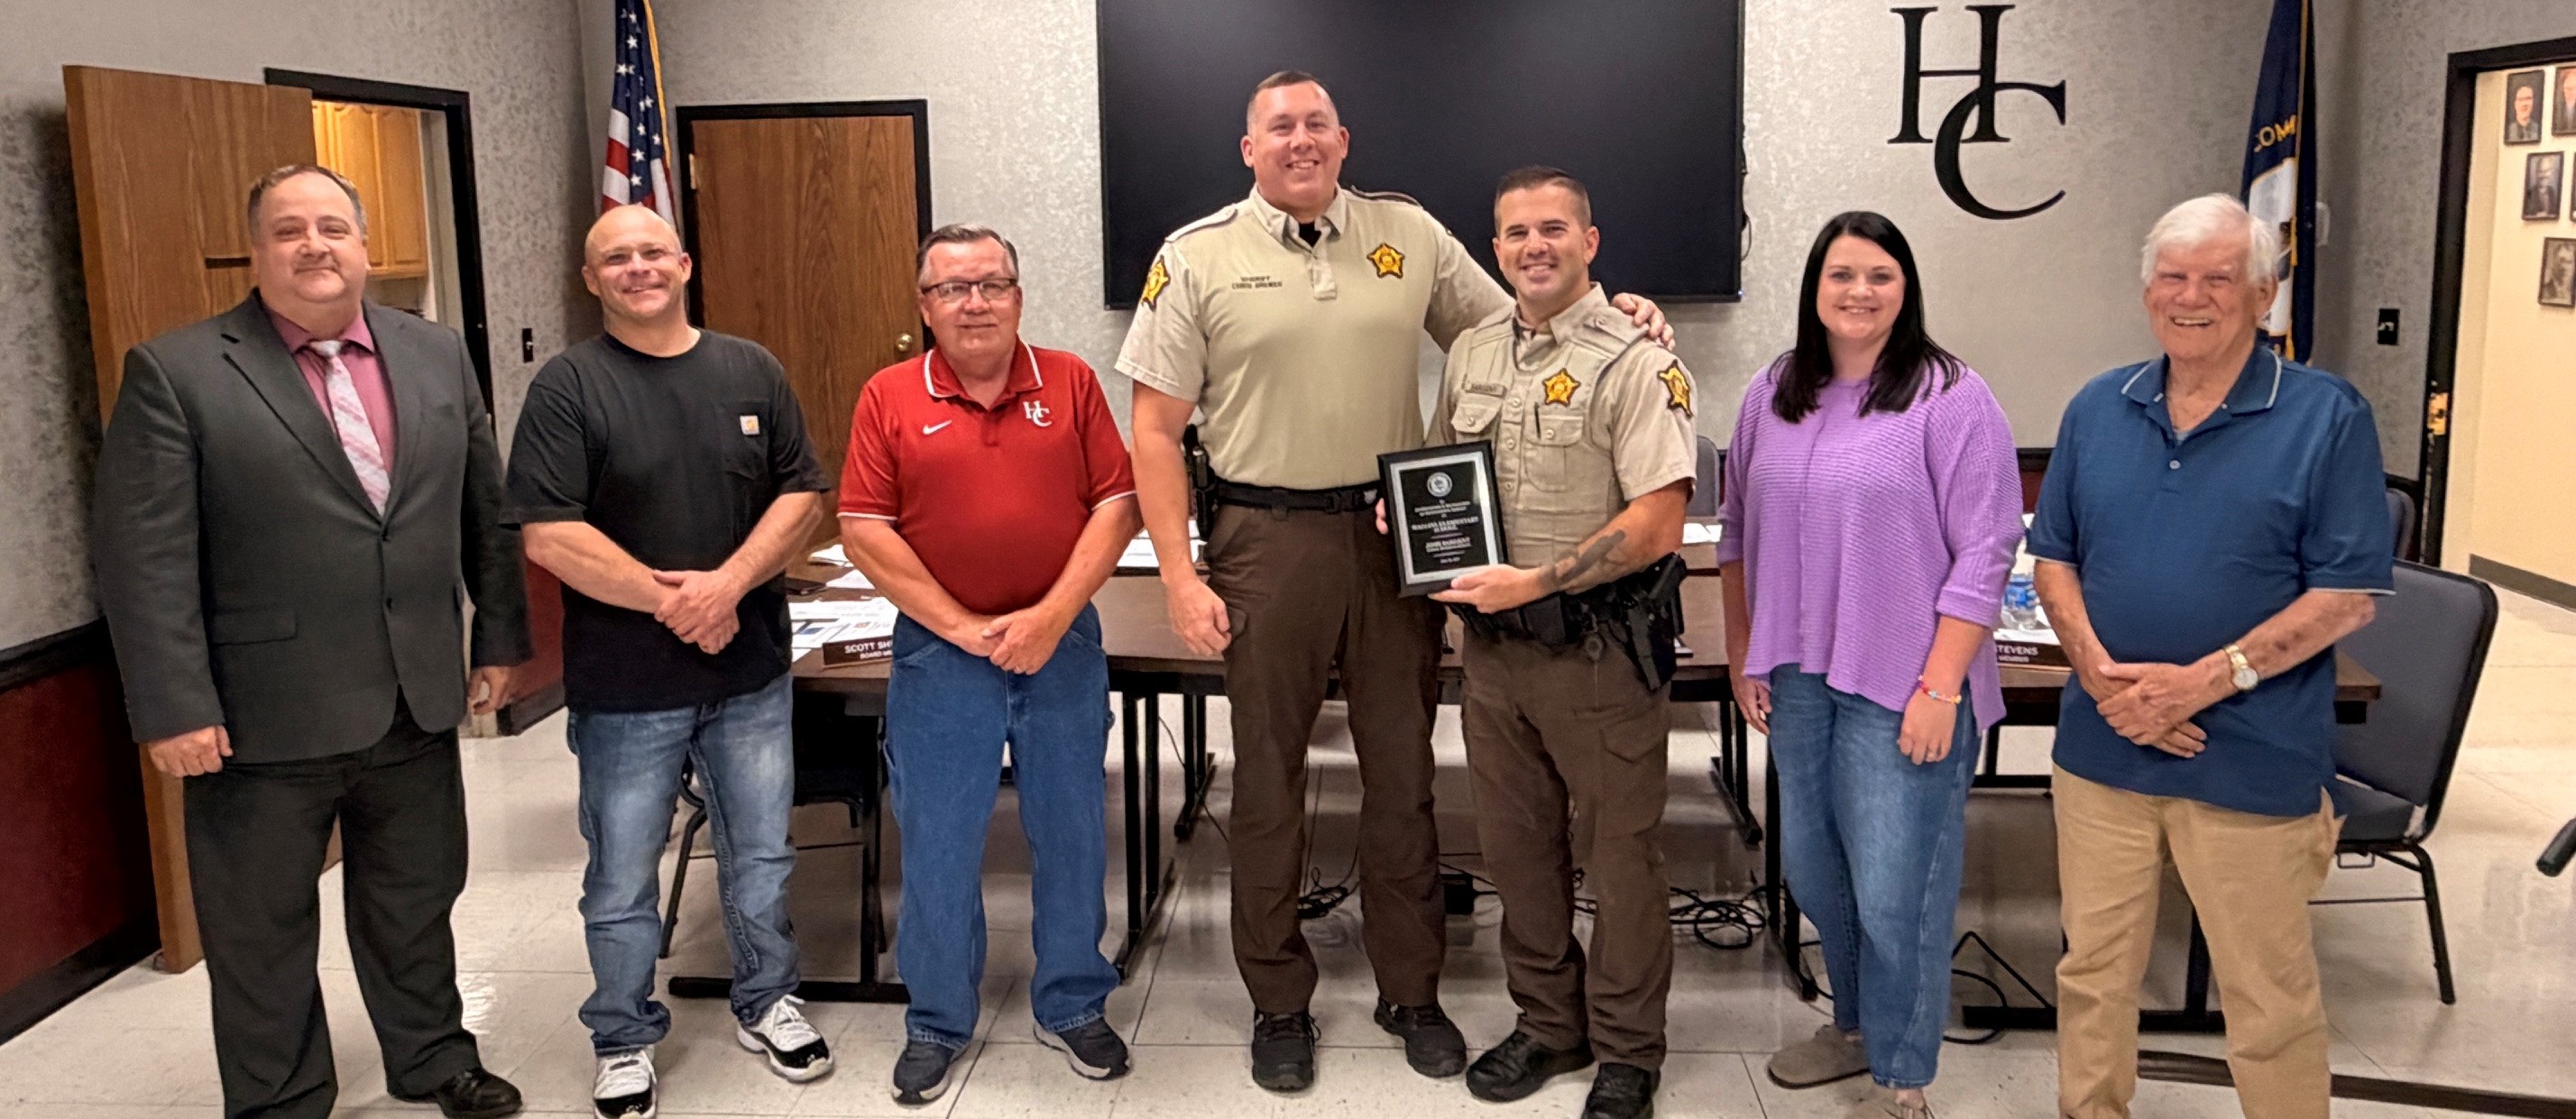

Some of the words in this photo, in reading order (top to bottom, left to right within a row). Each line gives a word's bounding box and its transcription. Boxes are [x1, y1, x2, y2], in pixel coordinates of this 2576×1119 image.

[1887, 5, 2065, 220] HC
[1022, 400, 1053, 427] HC
[844, 641, 875, 654] SCOTT
[1996, 644, 2038, 656] TEVENS
[860, 651, 882, 659] BOARD
